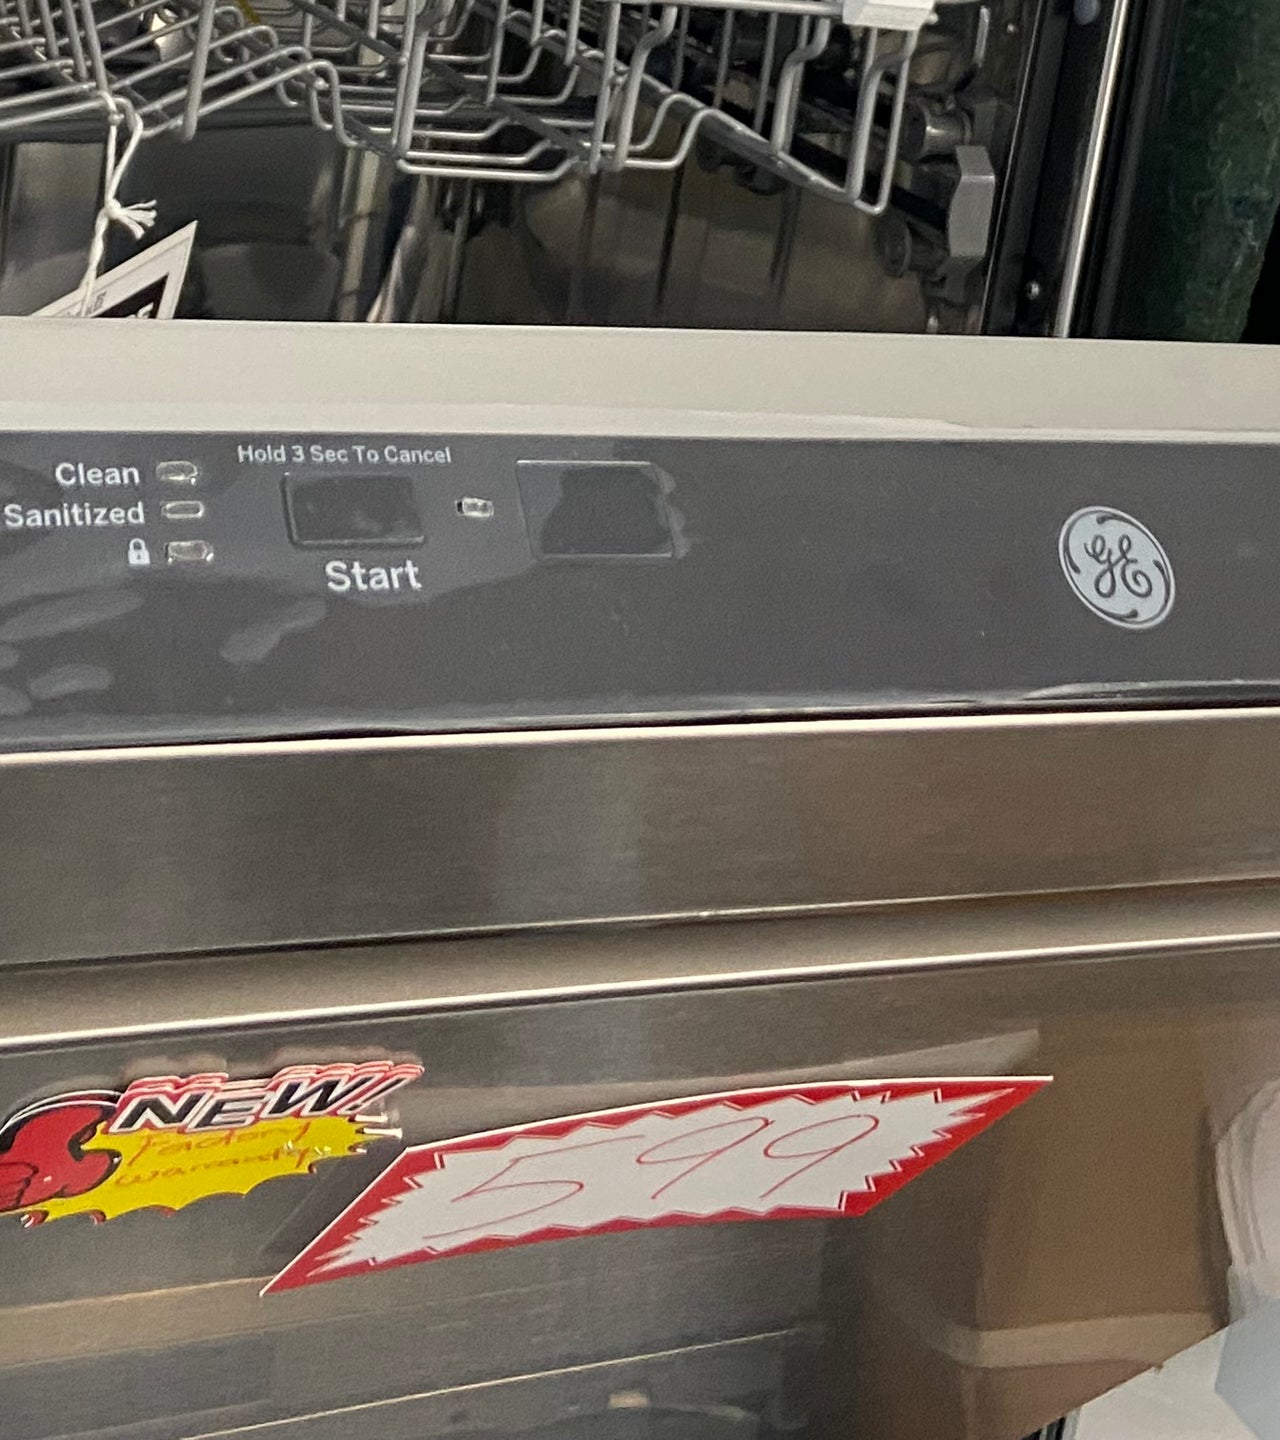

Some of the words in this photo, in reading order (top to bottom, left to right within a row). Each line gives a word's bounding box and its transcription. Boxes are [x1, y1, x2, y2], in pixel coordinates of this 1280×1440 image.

[237, 444, 286, 463] Hold
[291, 445, 305, 462] 3
[309, 445, 348, 463] Sec
[352, 445, 380, 463] To
[384, 445, 452, 463] Cancel
[55, 462, 140, 486] Clean
[4, 501, 145, 528] Sanitized
[324, 560, 422, 591] Start
[113, 1071, 417, 1132] NEW!
[422, 1113, 880, 1240] 599
